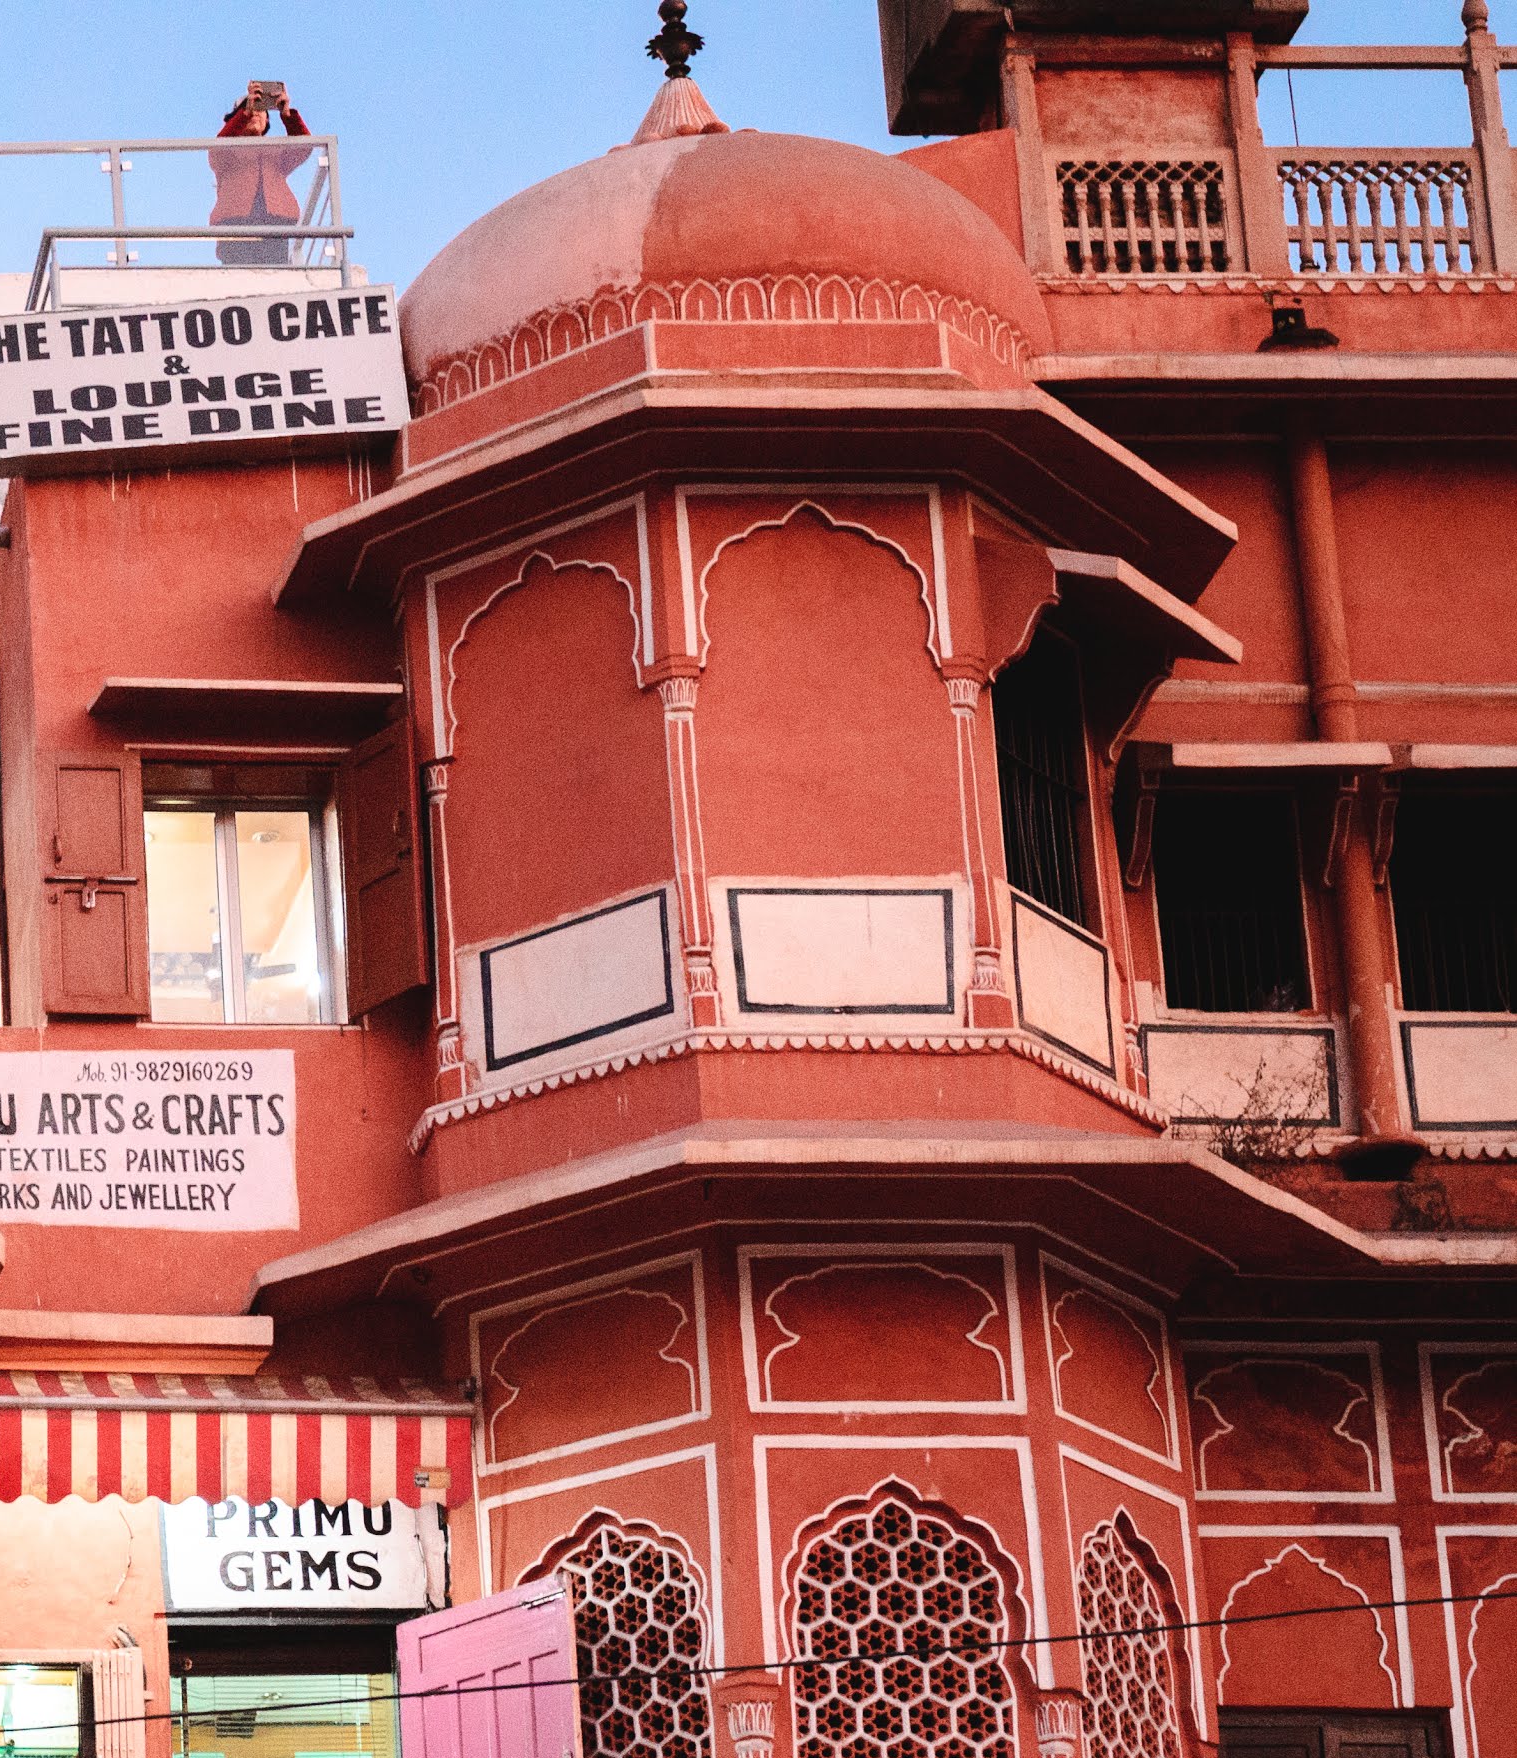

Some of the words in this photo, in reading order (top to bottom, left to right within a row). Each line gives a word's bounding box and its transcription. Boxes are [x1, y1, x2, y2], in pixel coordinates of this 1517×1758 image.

[61, 306, 252, 357] TATTOO
[268, 295, 391, 341] CAFE
[33, 368, 327, 415] LOUNGE
[188, 397, 385, 435] DINE
[37, 1094, 124, 1135] ARTS
[162, 1094, 285, 1136] CRAFTS
[126, 1149, 244, 1174] PAINTINGS
[52, 1185, 92, 1210] AND
[100, 1184, 236, 1211] JEWELLERY
[220, 1551, 381, 1591] GEMS
